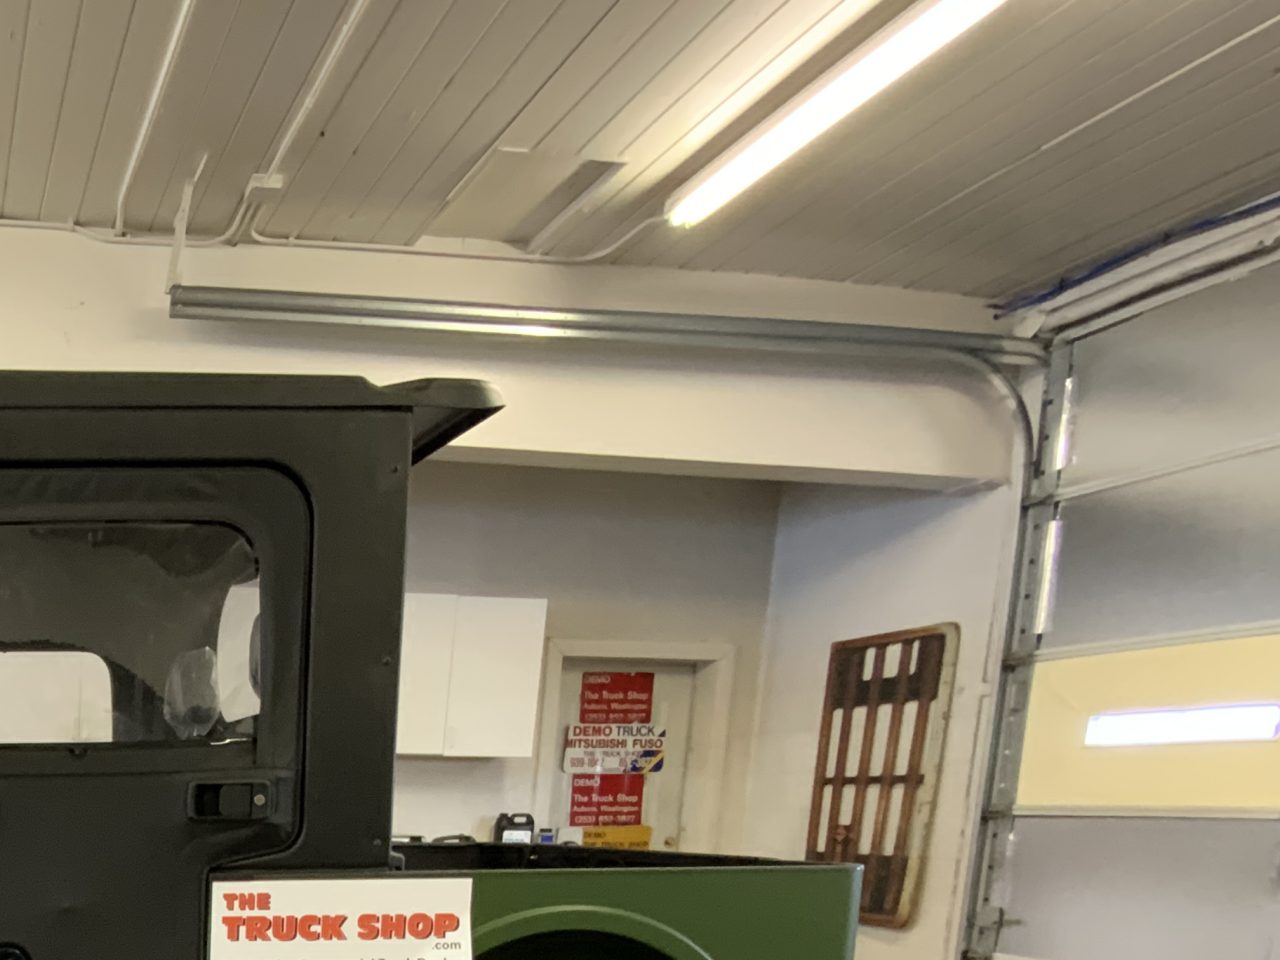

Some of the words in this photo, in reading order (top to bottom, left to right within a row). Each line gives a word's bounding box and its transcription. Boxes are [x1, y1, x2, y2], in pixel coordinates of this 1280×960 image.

[584, 690, 599, 700] The
[602, 690, 624, 700] Truck
[627, 690, 649, 701] Shop
[573, 726, 612, 736] DEMO
[616, 725, 655, 736] TRUCK
[566, 739, 627, 748] MITSUBISHI
[633, 739, 663, 748] FUSO
[574, 778, 600, 787] DEMO
[574, 793, 588, 802] The
[592, 793, 614, 802] Truck
[616, 793, 639, 803] Shop
[222, 893, 271, 911] THE
[222, 914, 348, 943] TRUCK
[357, 912, 461, 941] SHOP
[432, 941, 462, 950] .com
